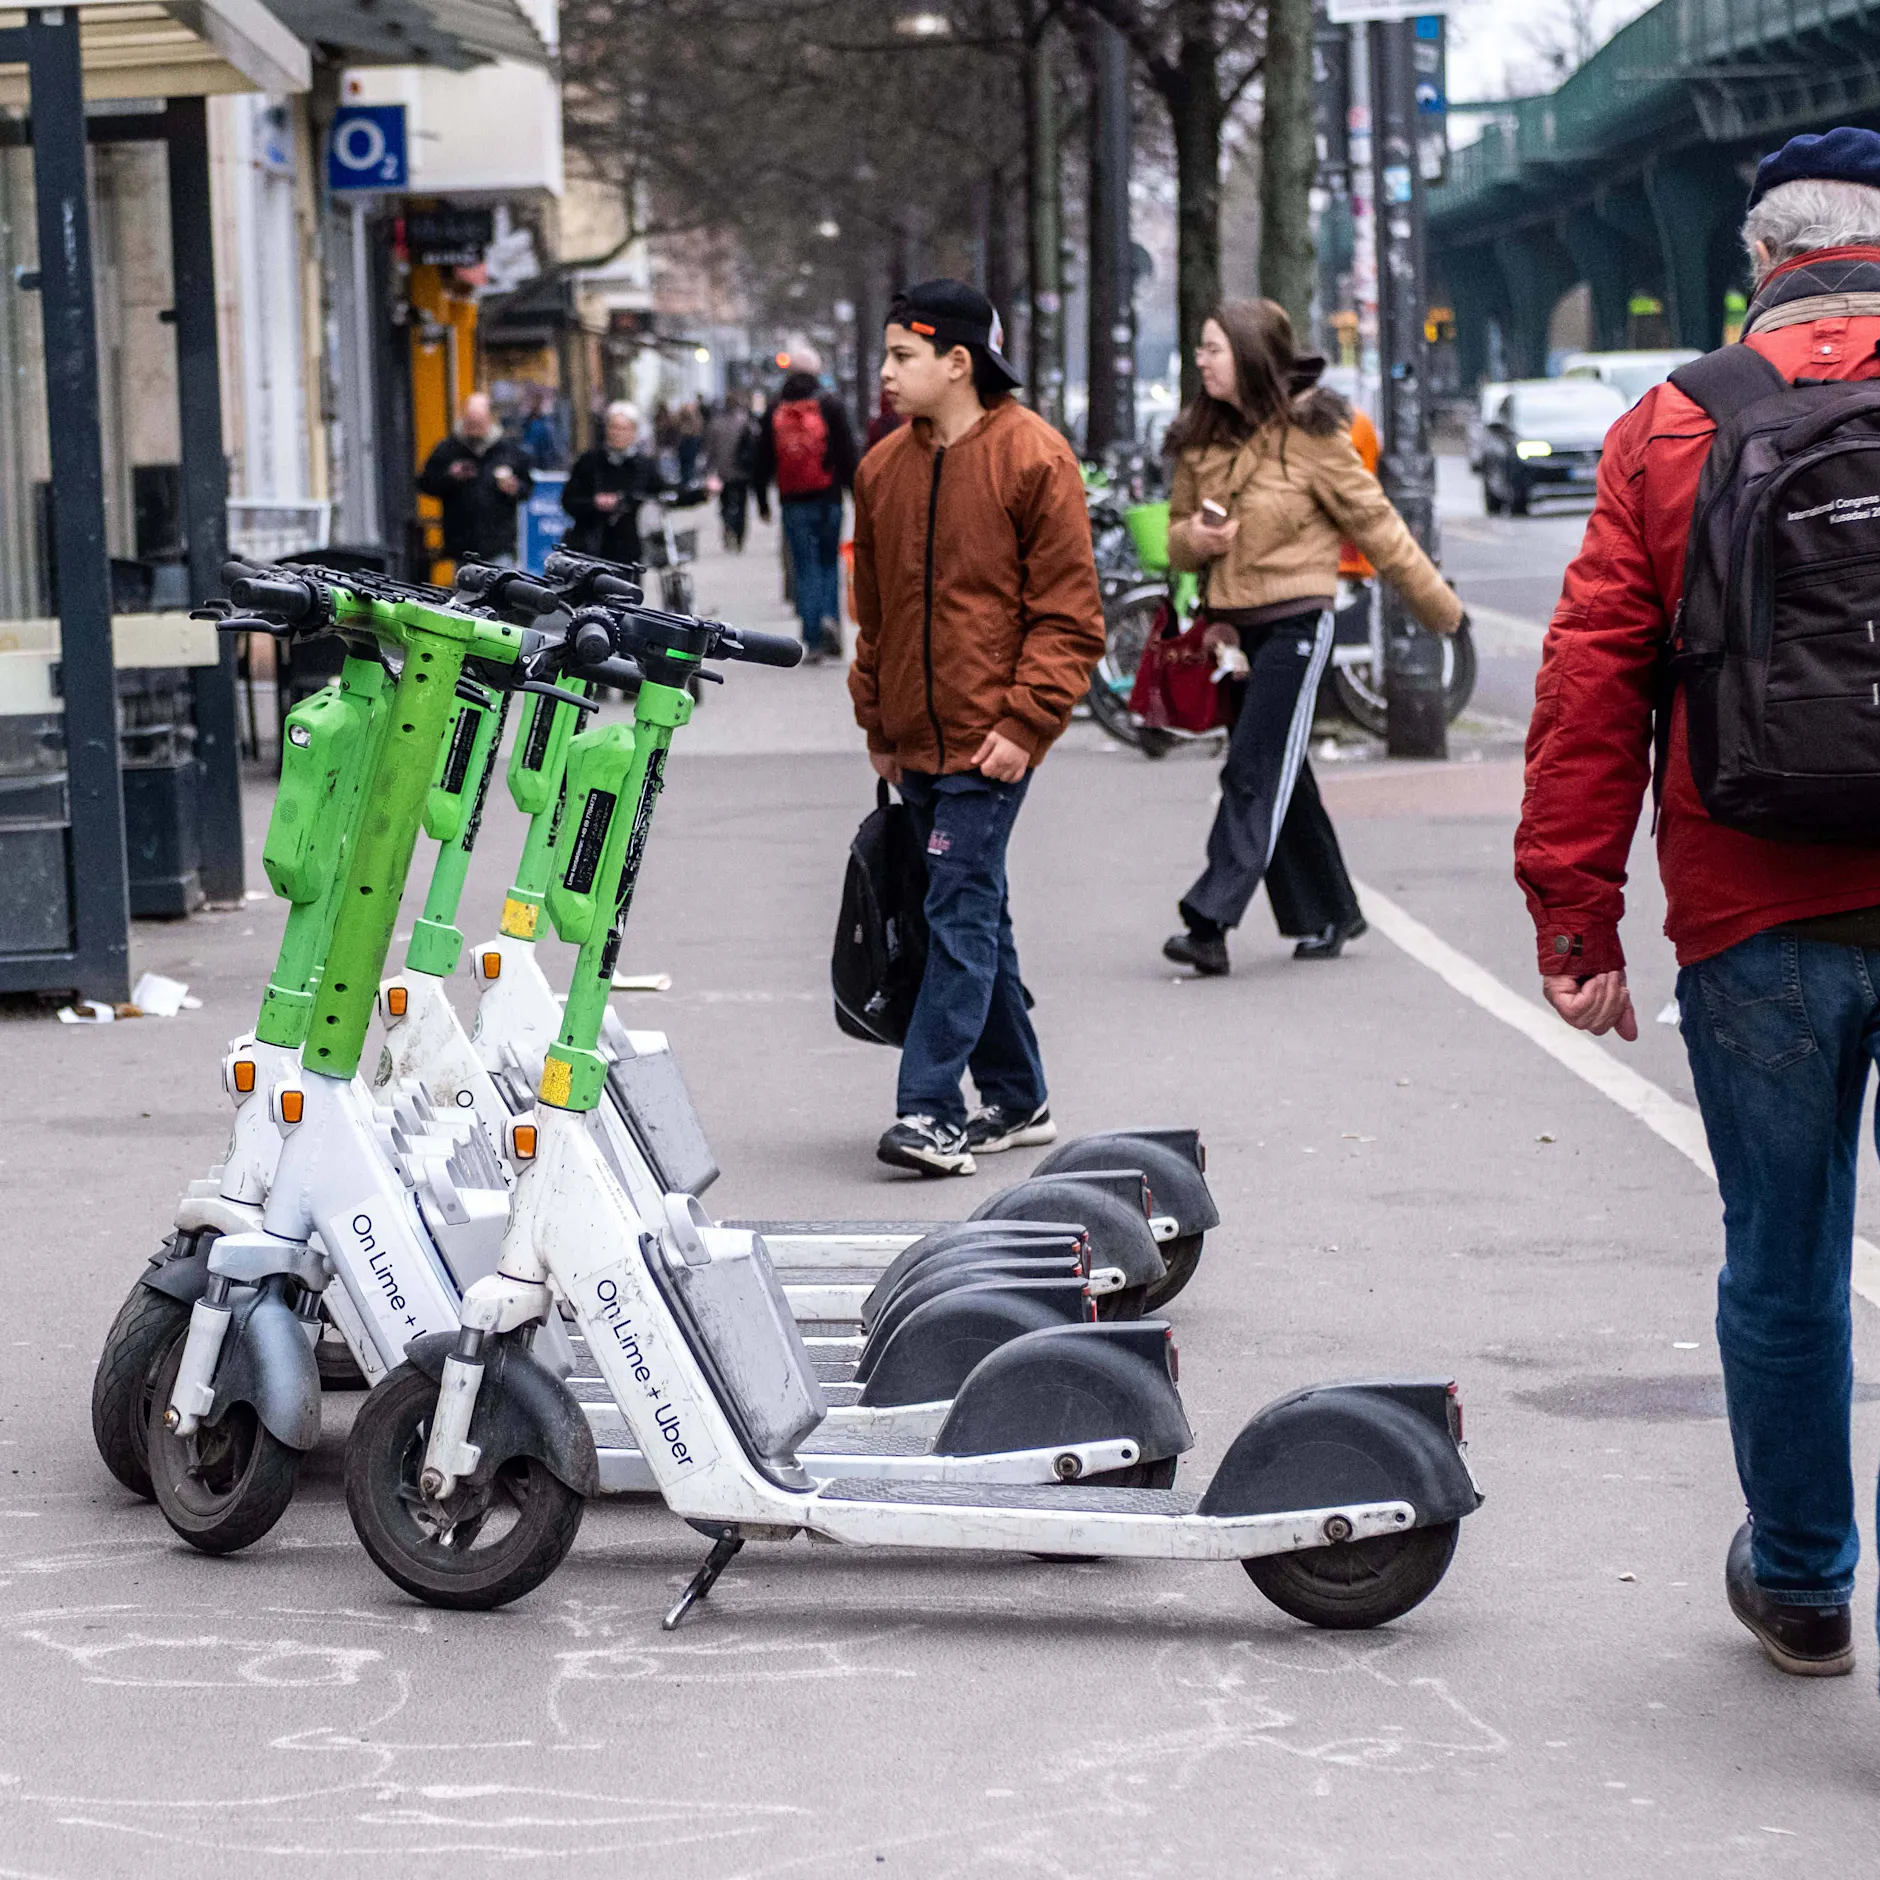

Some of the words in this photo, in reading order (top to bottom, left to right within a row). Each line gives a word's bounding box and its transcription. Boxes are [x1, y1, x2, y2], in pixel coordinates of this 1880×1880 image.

[1788, 500, 1836, 521] International
[1836, 495, 1880, 508] Congress
[353, 1214, 375, 1252] On
[369, 1251, 406, 1310] Lime
[405, 1315, 416, 1326] +
[597, 1279, 621, 1320] On
[613, 1319, 650, 1382] Lime
[648, 1386, 661, 1399] +
[654, 1403, 693, 1465] Uber
